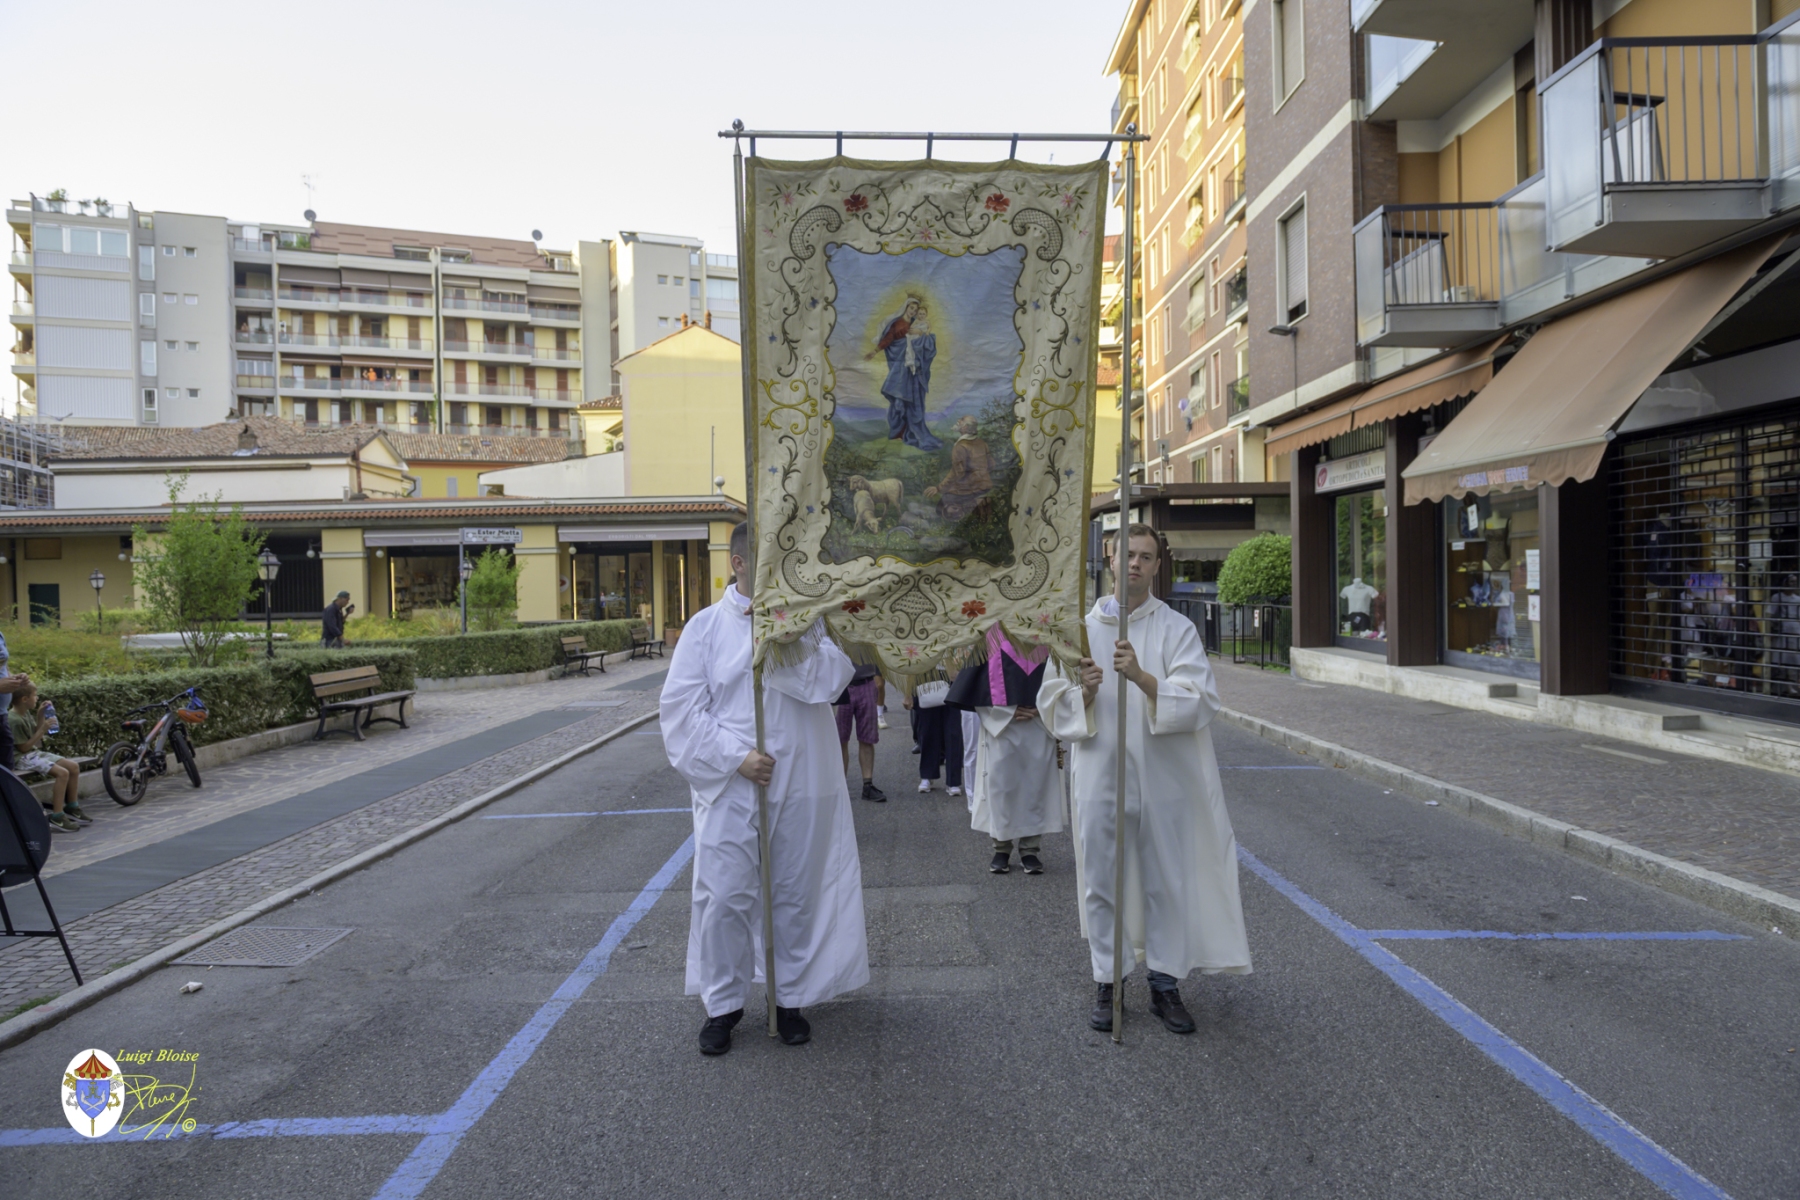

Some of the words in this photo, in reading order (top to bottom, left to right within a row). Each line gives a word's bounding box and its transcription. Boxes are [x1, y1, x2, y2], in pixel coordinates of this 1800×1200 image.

[1345, 456, 1371, 471] ARTICOLI
[1329, 470, 1360, 485] ORTOPEDICI
[1363, 466, 1384, 478] SANITA
